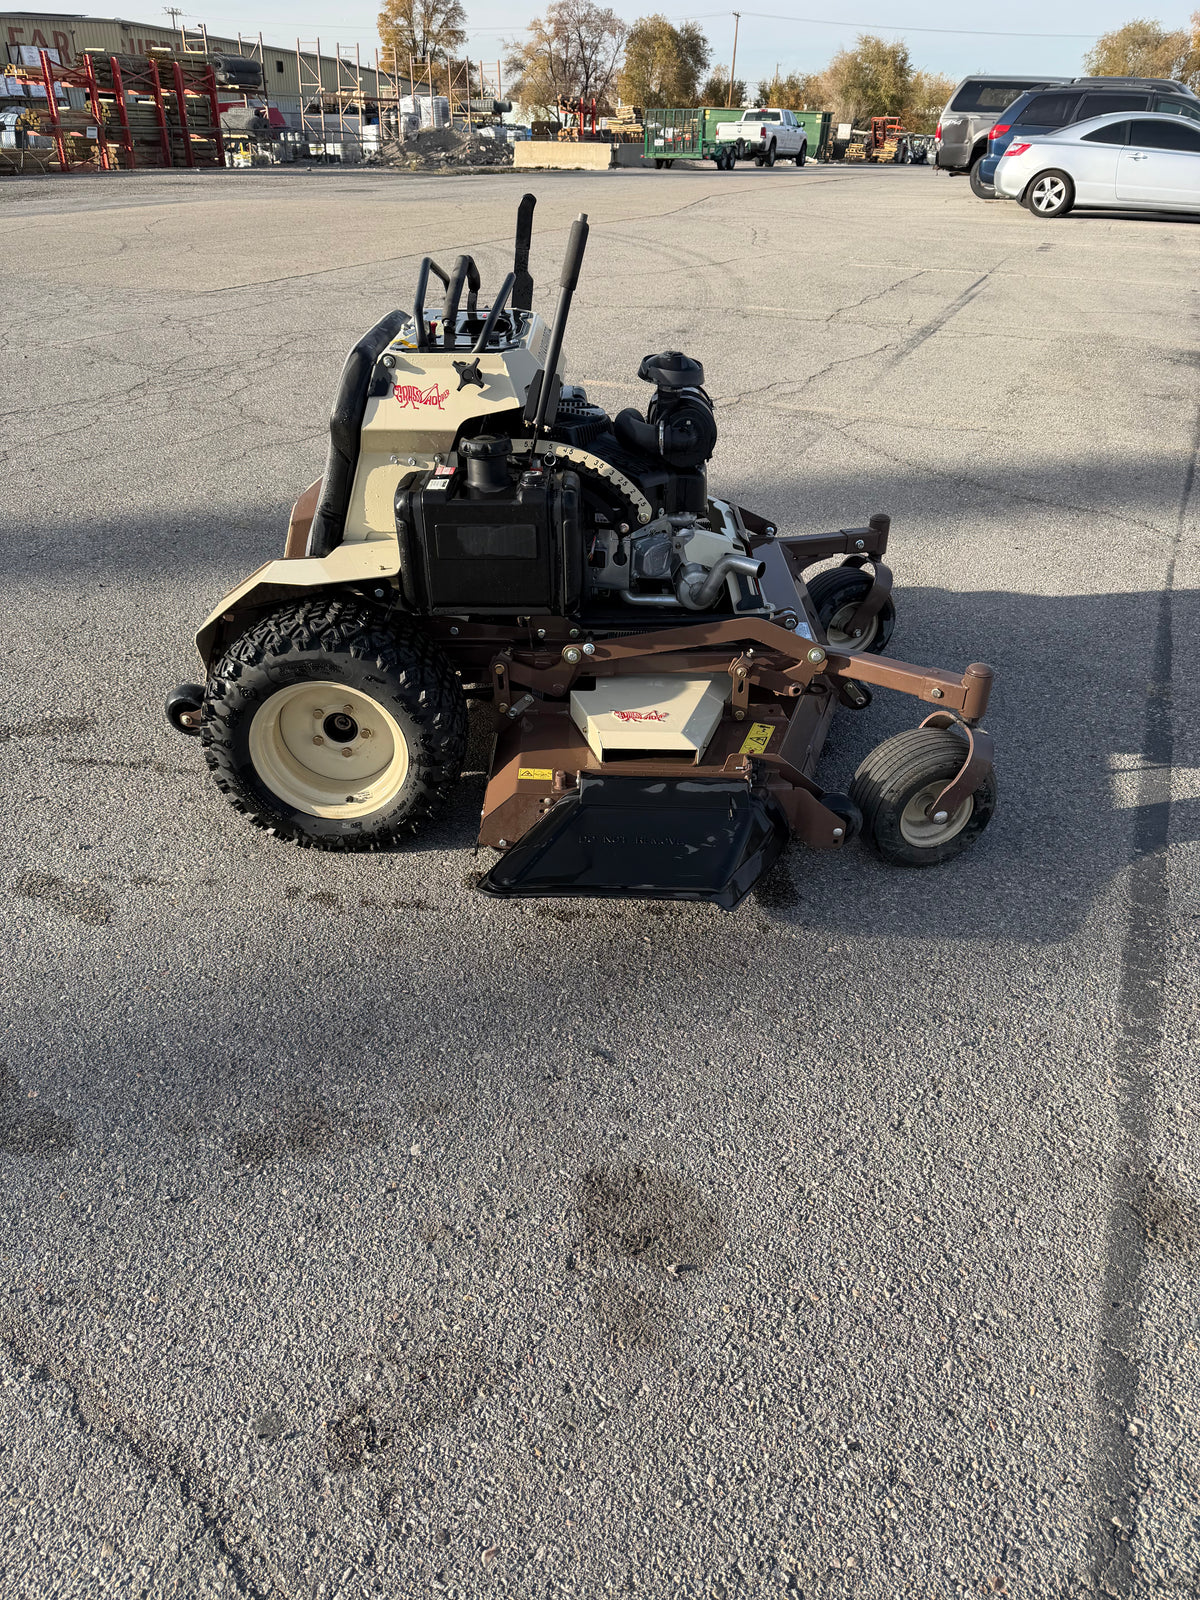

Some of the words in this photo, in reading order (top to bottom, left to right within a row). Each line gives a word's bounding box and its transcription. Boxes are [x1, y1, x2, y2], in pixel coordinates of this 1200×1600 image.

[594, 460, 605, 469] 3.5
[618, 477, 628, 487] 2.5
[638, 498, 647, 507] 1.5
